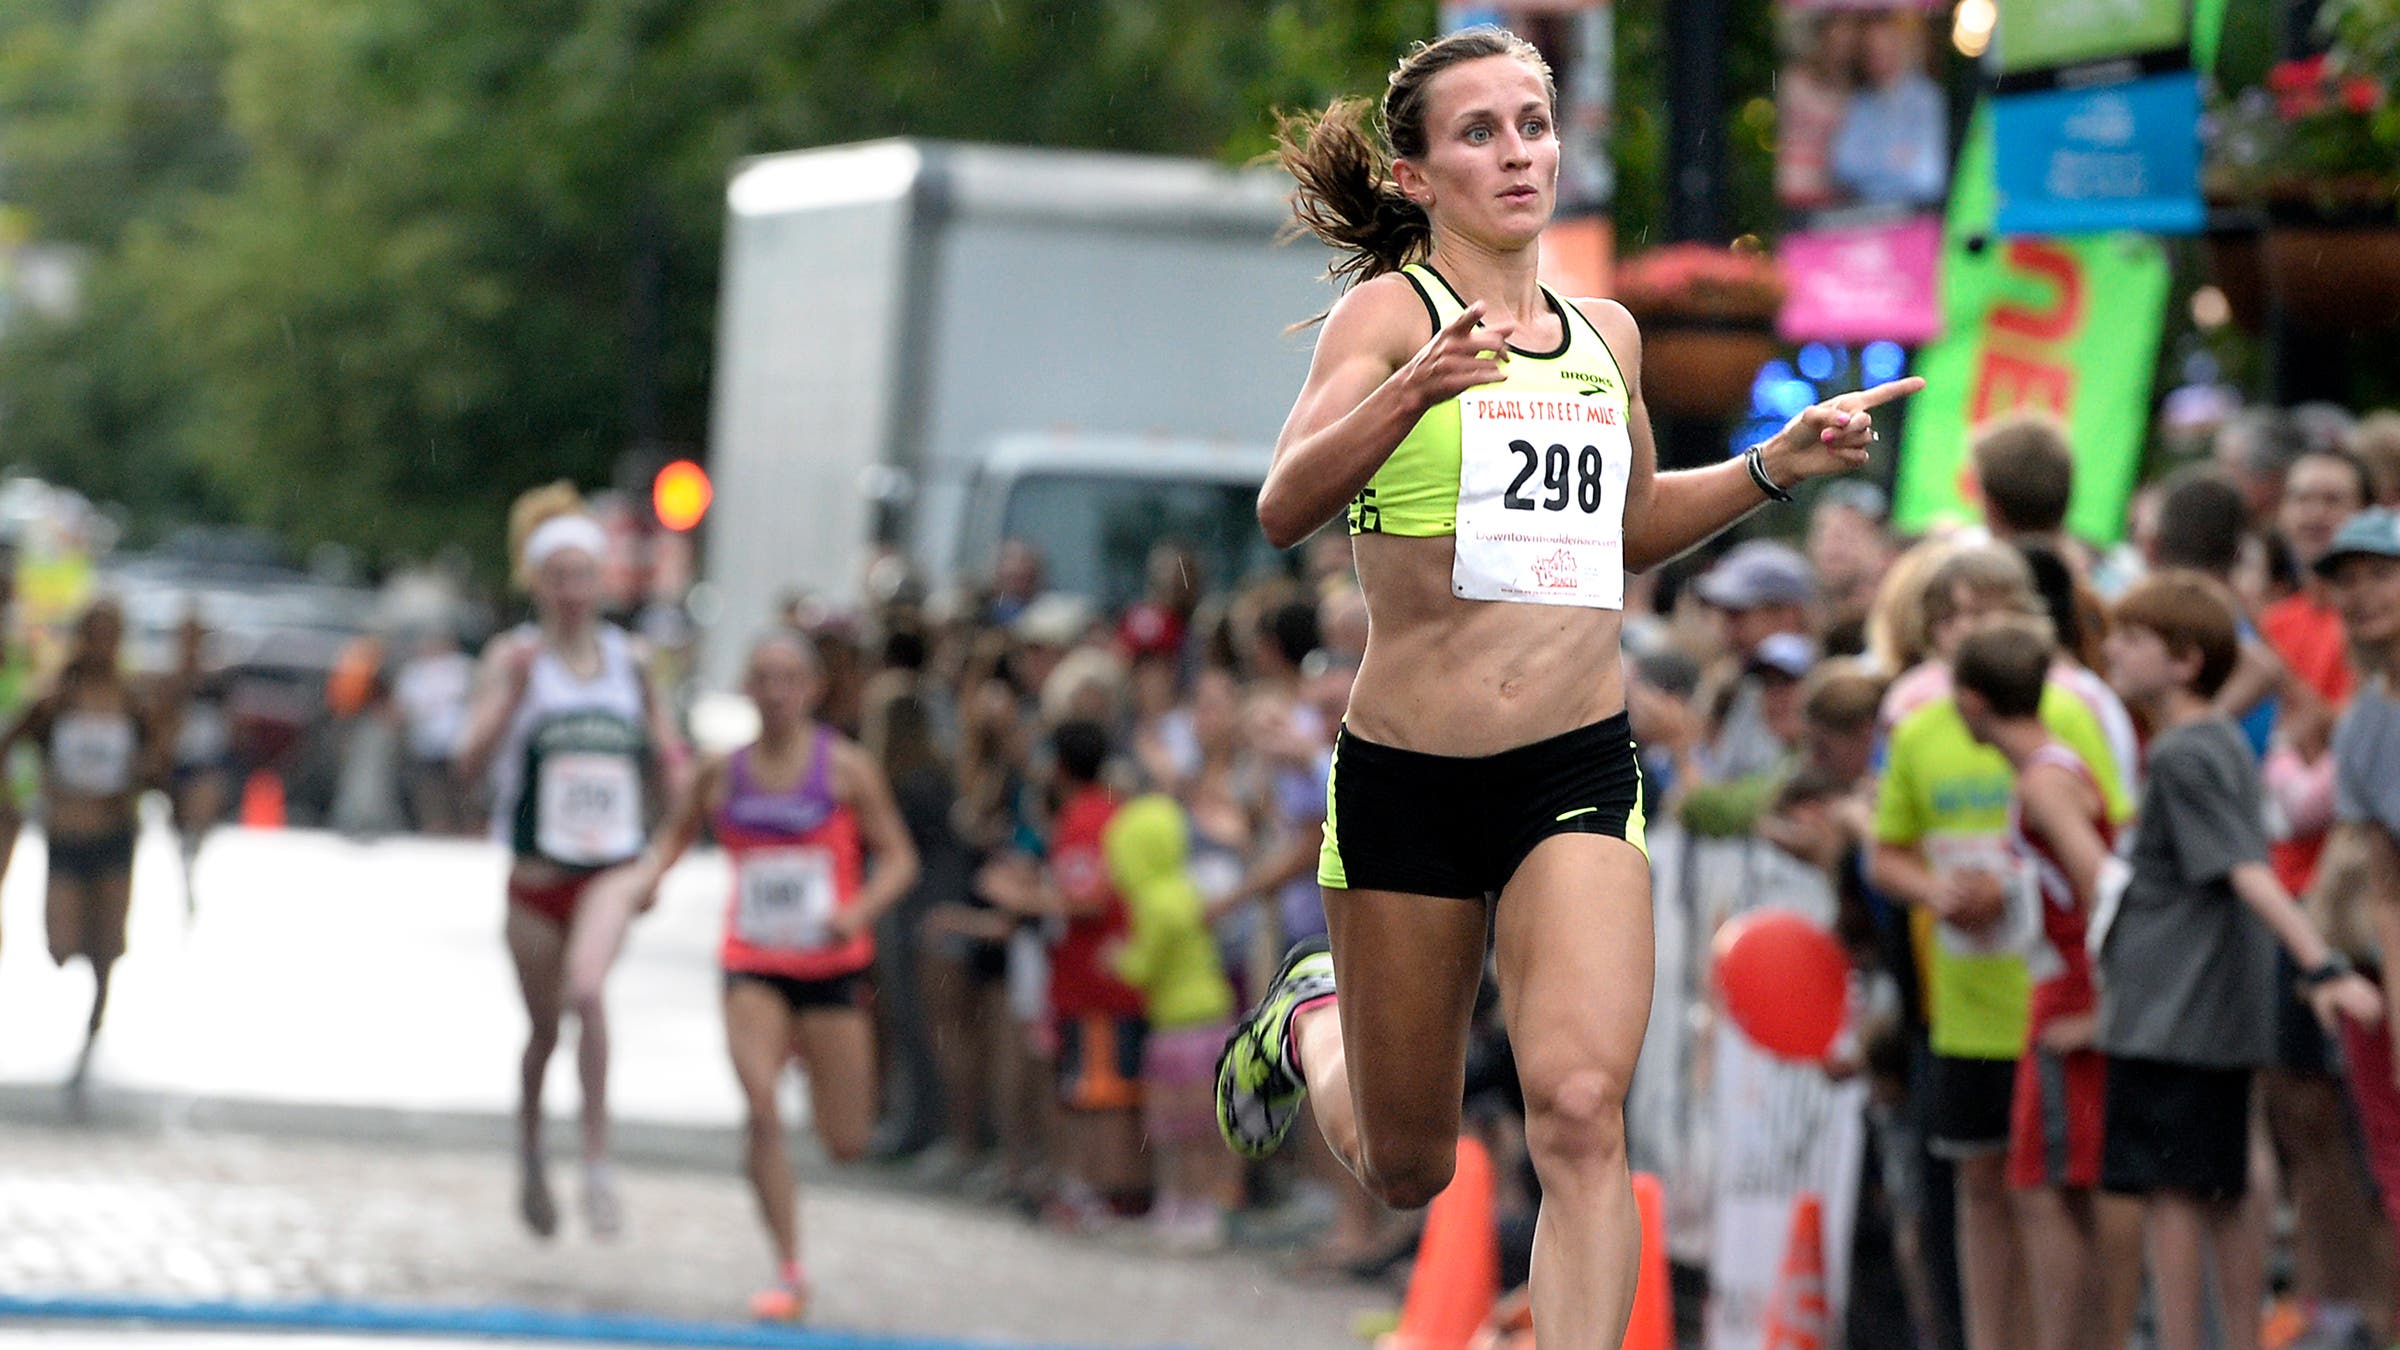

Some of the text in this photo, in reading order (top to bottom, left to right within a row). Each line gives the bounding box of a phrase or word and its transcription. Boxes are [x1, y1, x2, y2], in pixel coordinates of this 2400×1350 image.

[1560, 370, 1614, 388] BROOKS
[1478, 400, 1617, 426] PEARL STREET MILE
[1504, 439, 1602, 514] 298
